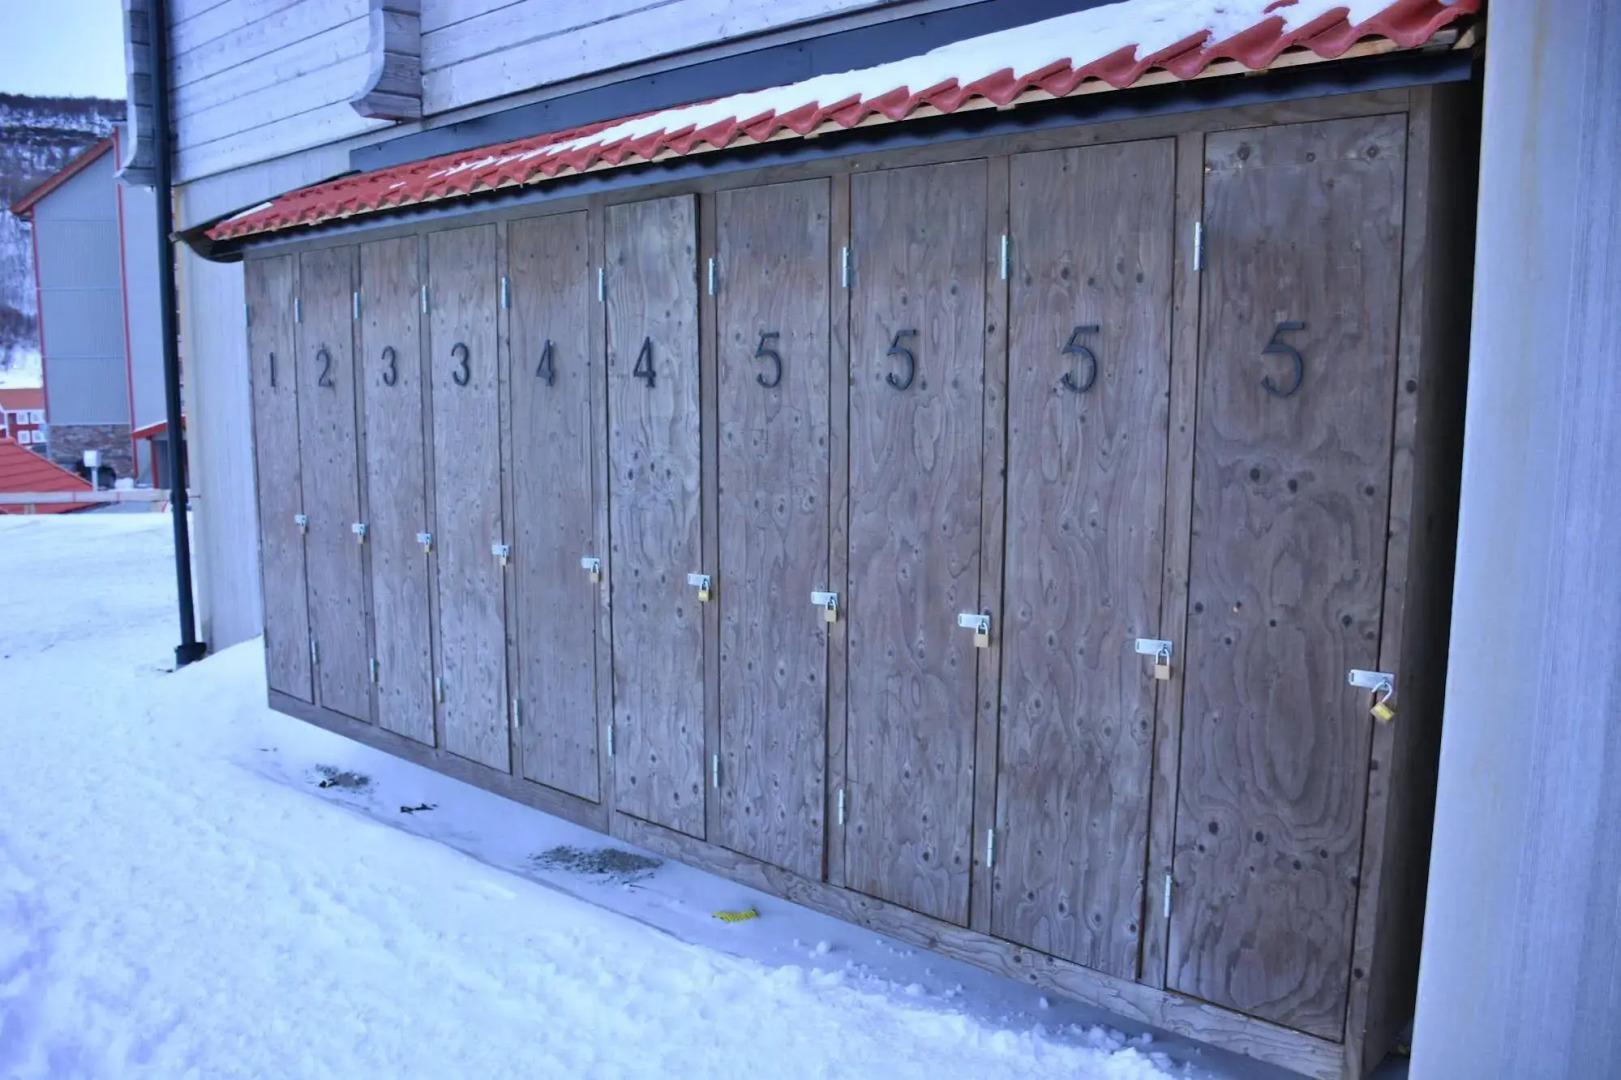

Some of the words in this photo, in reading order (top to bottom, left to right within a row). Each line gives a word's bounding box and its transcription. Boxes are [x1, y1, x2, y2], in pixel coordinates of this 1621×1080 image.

[269, 352, 276, 387] 1
[316, 348, 333, 387] 2
[381, 346, 397, 387] 3
[451, 342, 470, 387] 3
[536, 338, 556, 387] 4
[633, 336, 656, 388] 4
[755, 331, 782, 388] 5
[886, 329, 918, 391] 5
[1061, 325, 1099, 393] 5
[1260, 321, 1305, 397] 5
